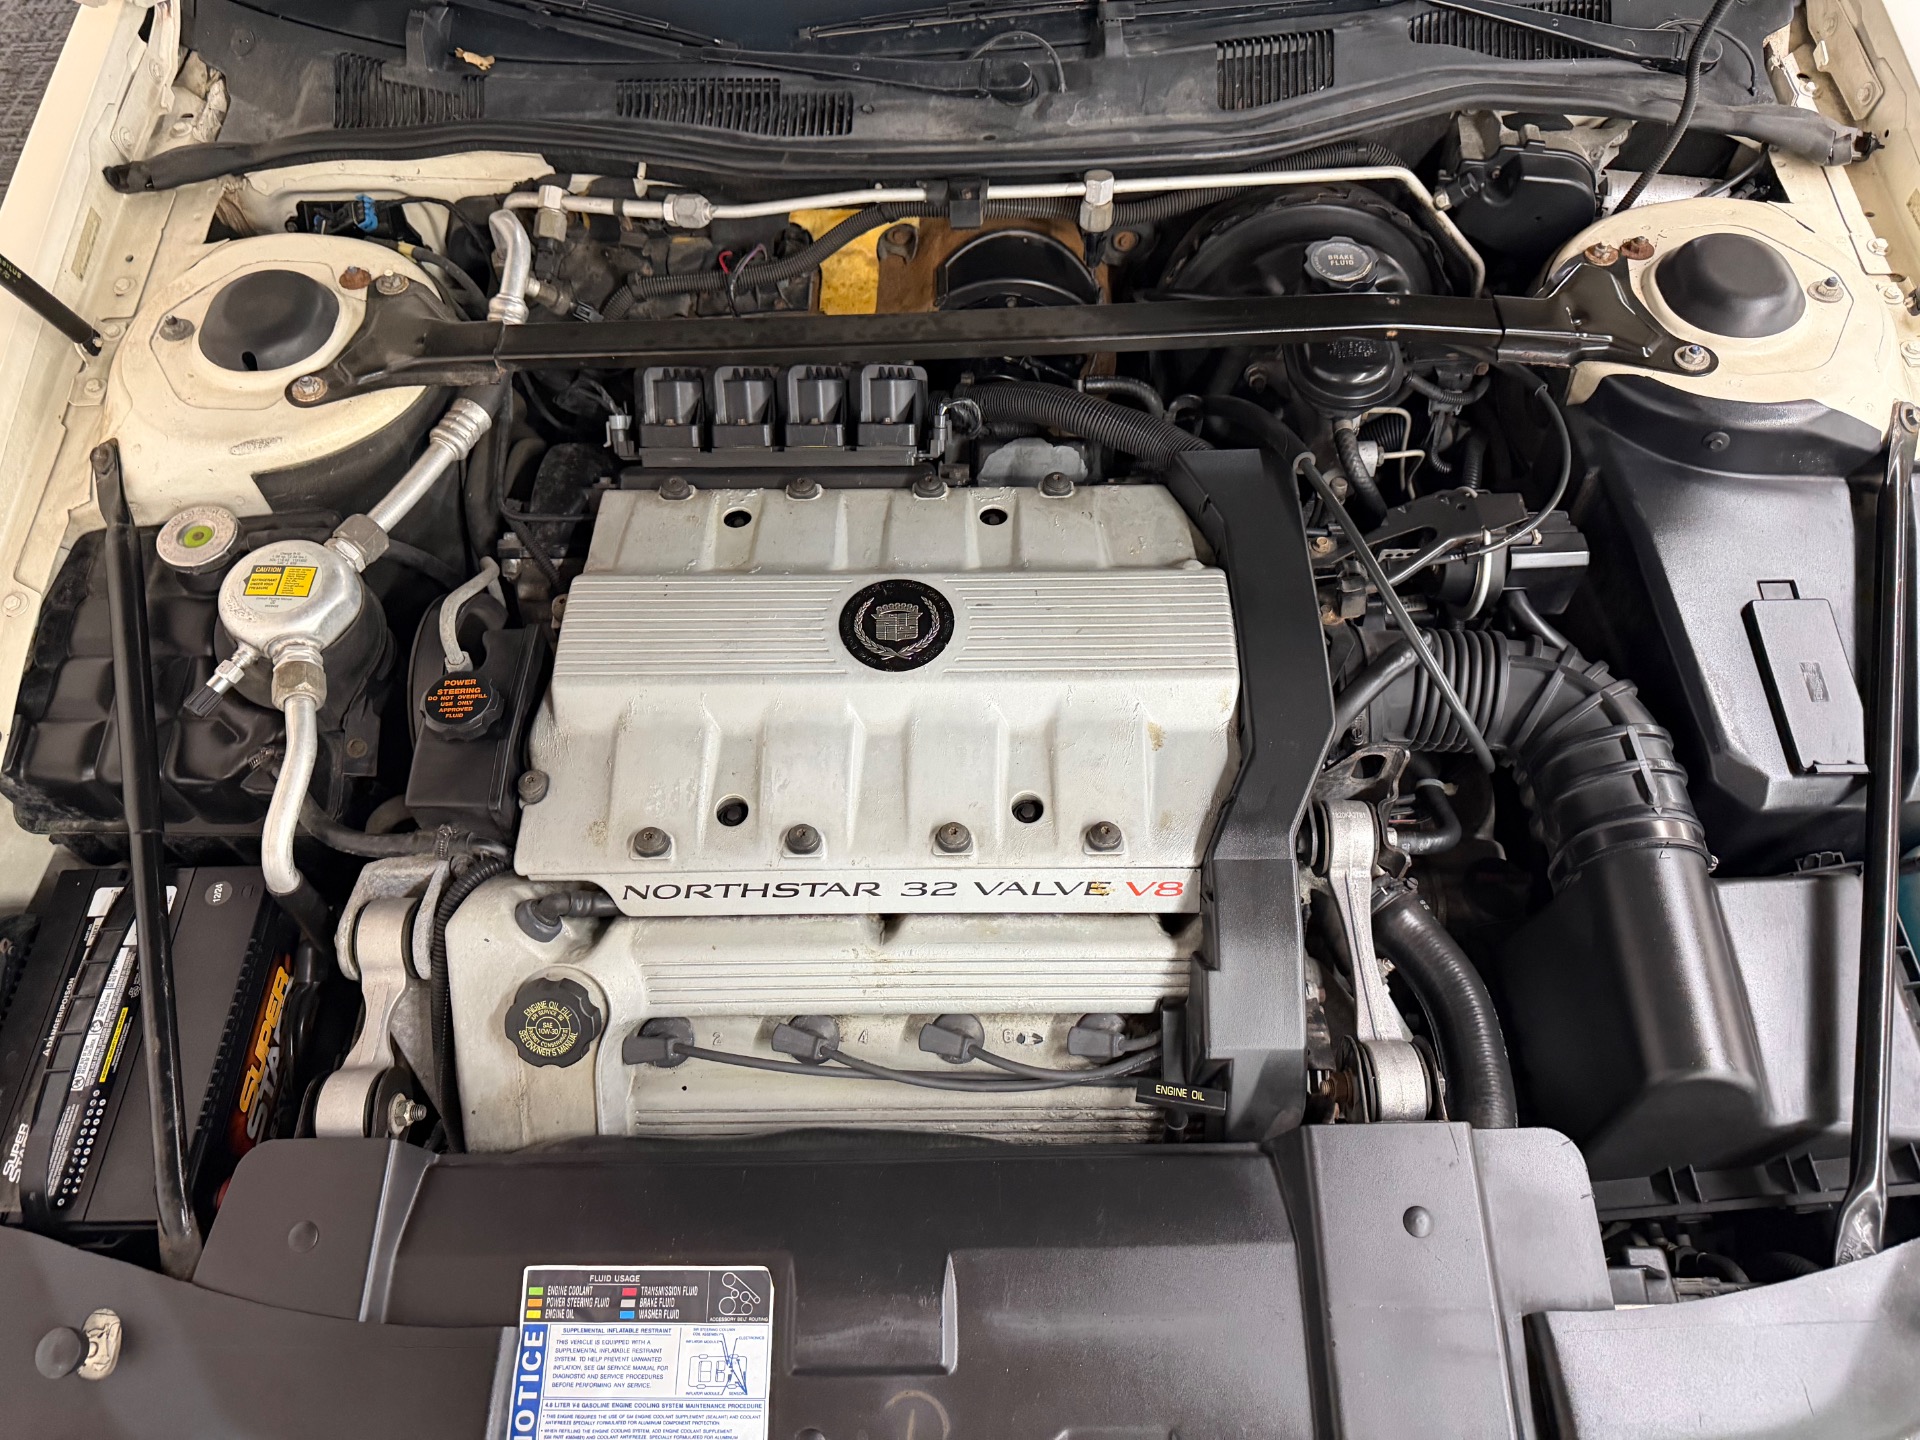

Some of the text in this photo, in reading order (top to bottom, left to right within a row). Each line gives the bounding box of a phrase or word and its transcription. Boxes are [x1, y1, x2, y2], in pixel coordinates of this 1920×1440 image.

[437, 687, 481, 695] STEERING
[212, 883, 224, 903] 12/24
[622, 881, 1184, 900] NORTHSTAR 32 VALVE V8
[46, 977, 75, 1048] DANGER/POISON
[524, 1000, 573, 1020] ENGINE OIL FILL
[538, 1008, 557, 1016] SERVICE
[239, 965, 290, 1113] SUPER
[519, 1030, 578, 1057] SEE OWNER'S MANUAL
[528, 1028, 567, 1048] ENERGY CONSERVING
[1156, 1084, 1205, 1102] ENGINE OIL
[2, 1123, 30, 1176] SUPER
[548, 1286, 593, 1296] ENGINE COOLANT
[641, 1286, 698, 1295] TRANSMISSION FLUID
[546, 1298, 610, 1307] POWER STEERING FLUID
[639, 1298, 675, 1307] BRAKE FLUID
[545, 1310, 575, 1319] ENGINE OIL
[639, 1309, 680, 1319] WASHER FLUID
[513, 1331, 544, 1440] OTICE
